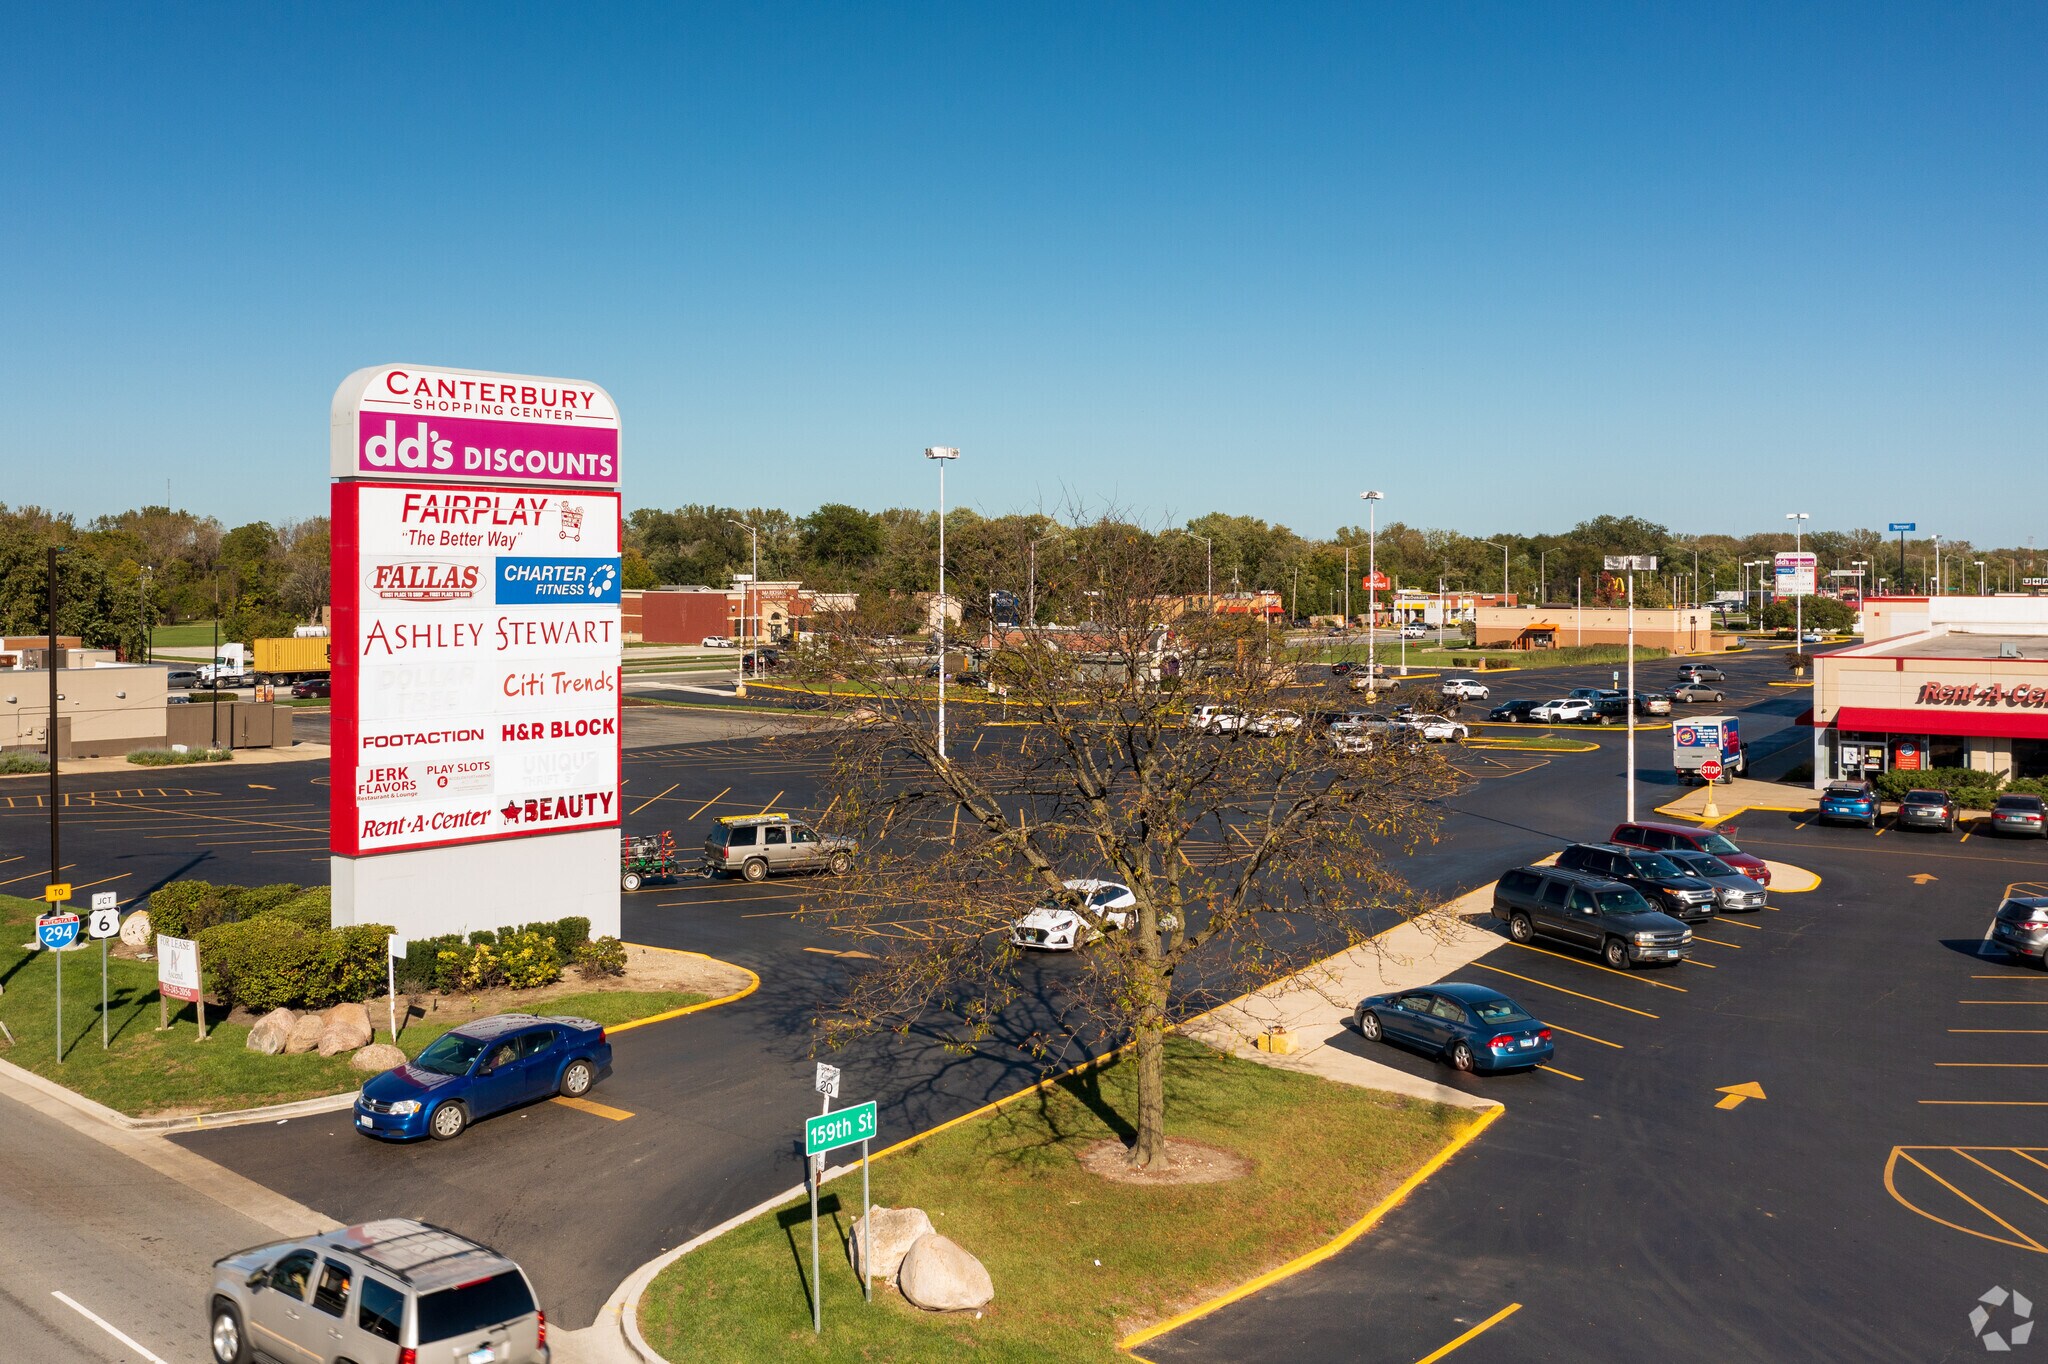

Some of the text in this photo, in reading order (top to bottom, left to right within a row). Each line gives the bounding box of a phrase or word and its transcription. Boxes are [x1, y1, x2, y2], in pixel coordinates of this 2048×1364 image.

[386, 371, 595, 410] CANTERBURY
[413, 399, 573, 421] SHOPPING CENTER
[365, 420, 612, 477] dd's DISCOUNTS
[402, 493, 548, 526] FAIRPLAY
[440, 531, 484, 547] Better
[373, 565, 479, 589] FALLAS
[504, 565, 587, 582] CHARTER
[535, 583, 585, 595] FITNESS
[364, 619, 484, 656] ASHLEY
[496, 616, 614, 651] STEWART
[503, 670, 614, 697] Citi Trends
[363, 729, 484, 748] FOOTACTION
[502, 718, 615, 742] H&R BLOCK
[366, 767, 409, 783] JERK
[427, 761, 491, 775] PLAY SLOTS
[1702, 766, 1720, 774] STOP
[359, 780, 417, 795] FLAVORS
[525, 791, 614, 823] BEAUTY
[97, 896, 112, 905] JCT
[99, 915, 110, 931] 6
[45, 925, 73, 942] 294
[160, 936, 191, 951] FOR LEASE
[820, 1080, 833, 1094] 20
[811, 1111, 873, 1145] 159th St
